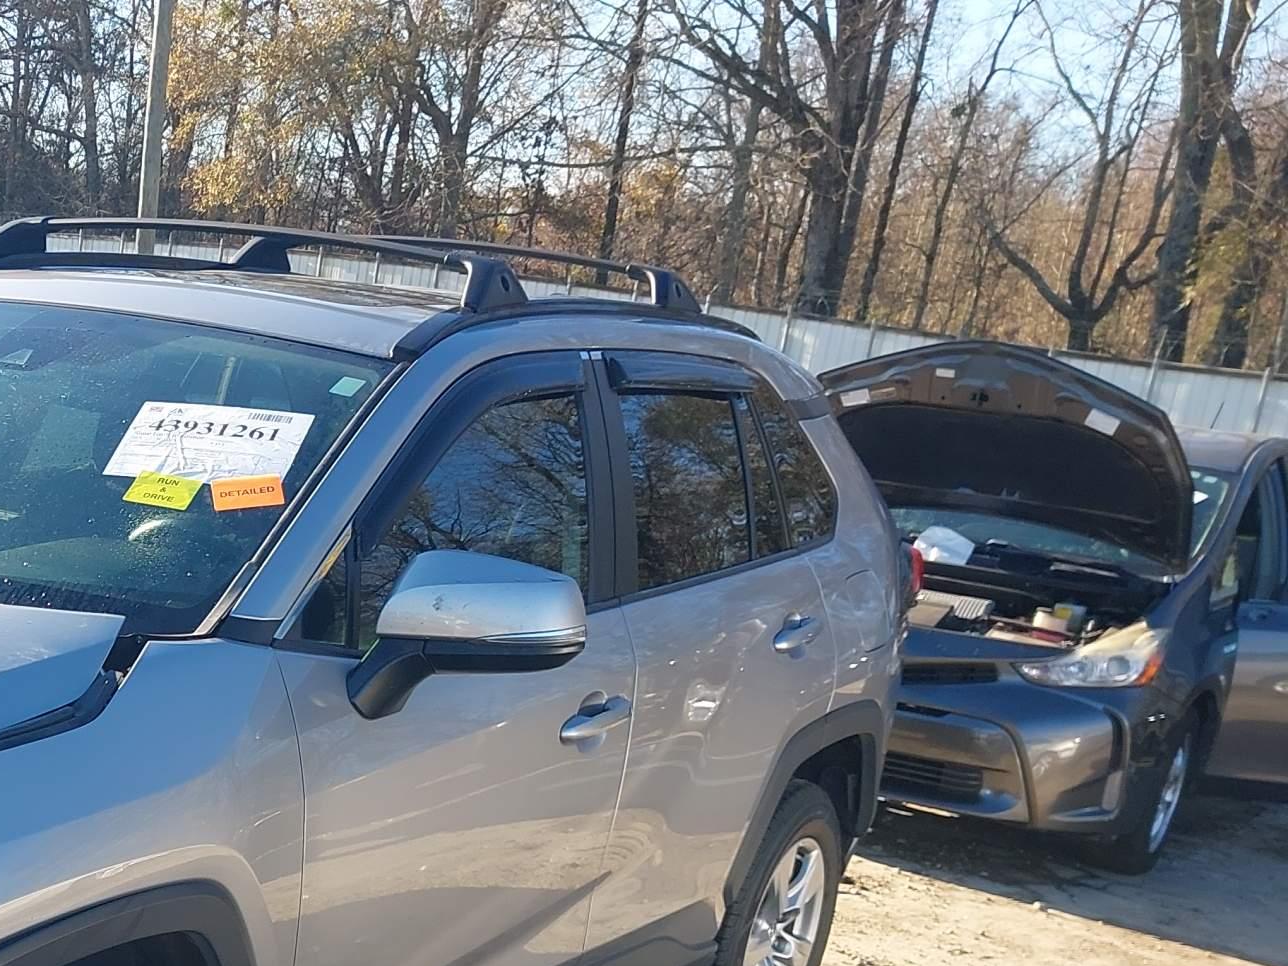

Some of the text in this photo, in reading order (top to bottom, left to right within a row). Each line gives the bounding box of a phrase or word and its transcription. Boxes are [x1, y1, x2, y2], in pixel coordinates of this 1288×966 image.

[148, 418, 281, 442] 43931261
[157, 477, 180, 487] RUN
[159, 486, 167, 494] &
[219, 485, 276, 499] DETAILED
[143, 492, 175, 504] DRIVE
